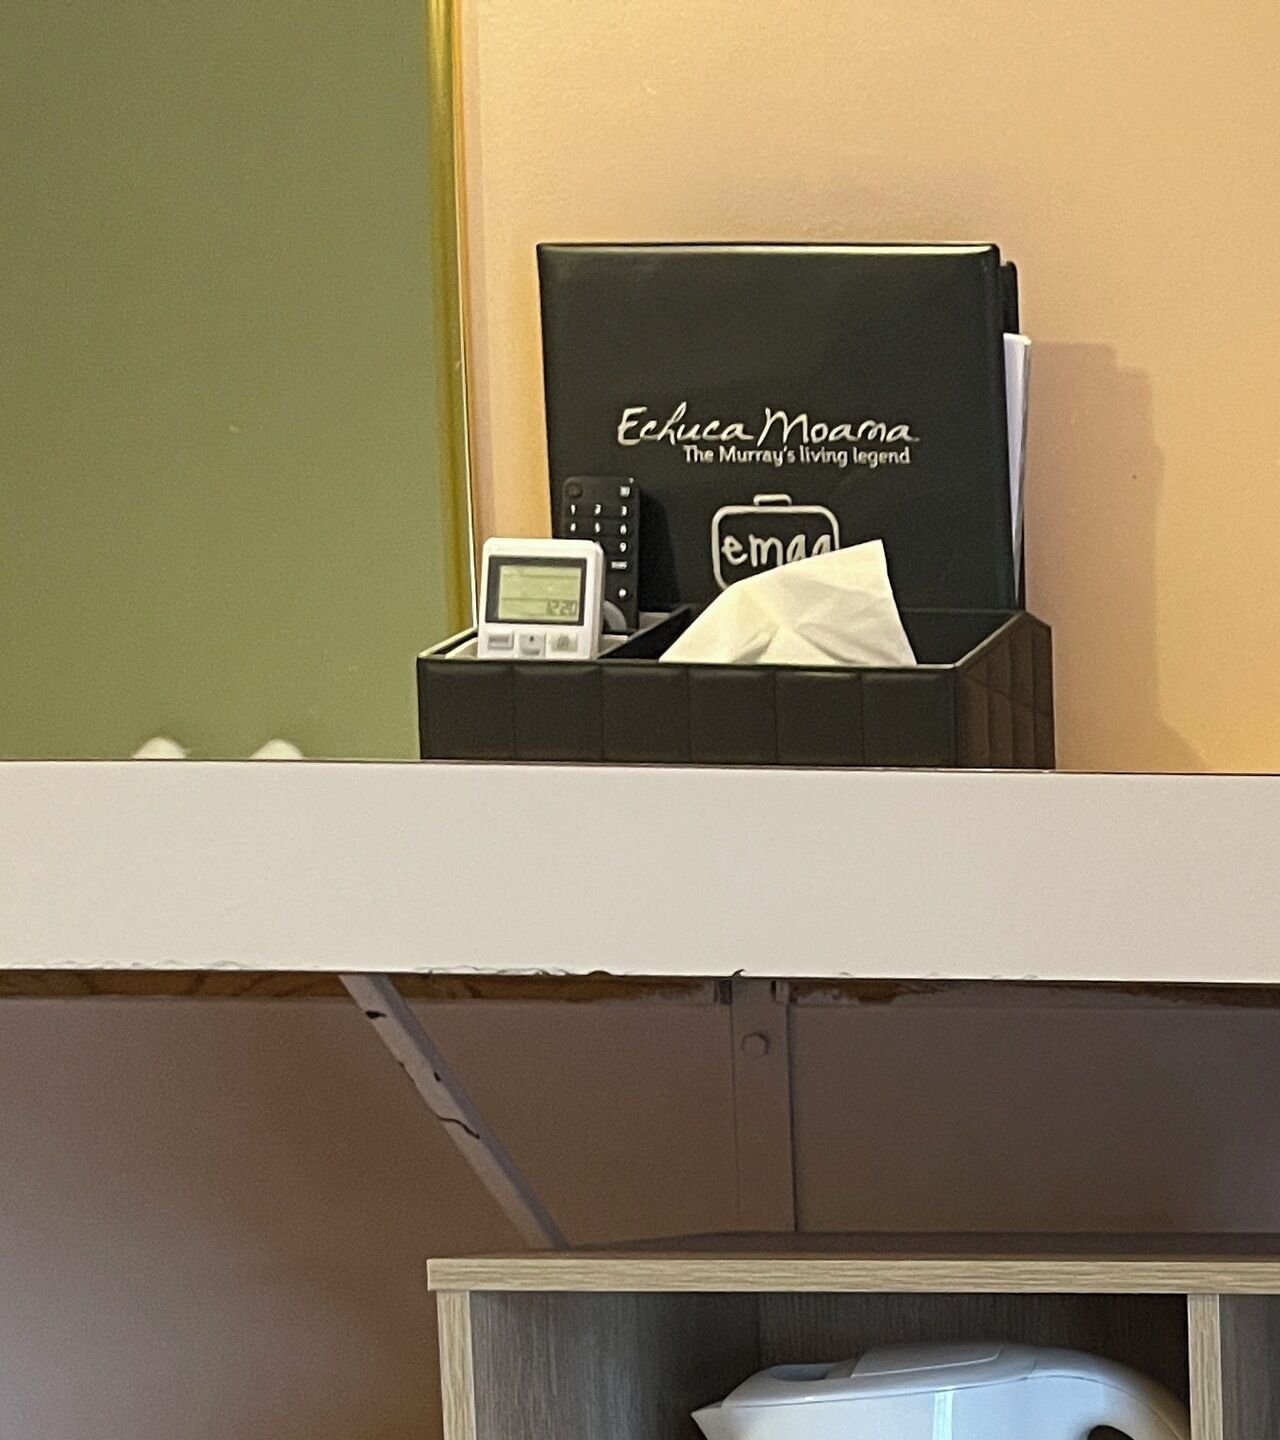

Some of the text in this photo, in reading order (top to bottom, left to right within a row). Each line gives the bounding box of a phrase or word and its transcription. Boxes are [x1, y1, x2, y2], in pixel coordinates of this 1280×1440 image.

[617, 401, 754, 446] Echuca
[683, 446, 911, 468] The Murray's living legend
